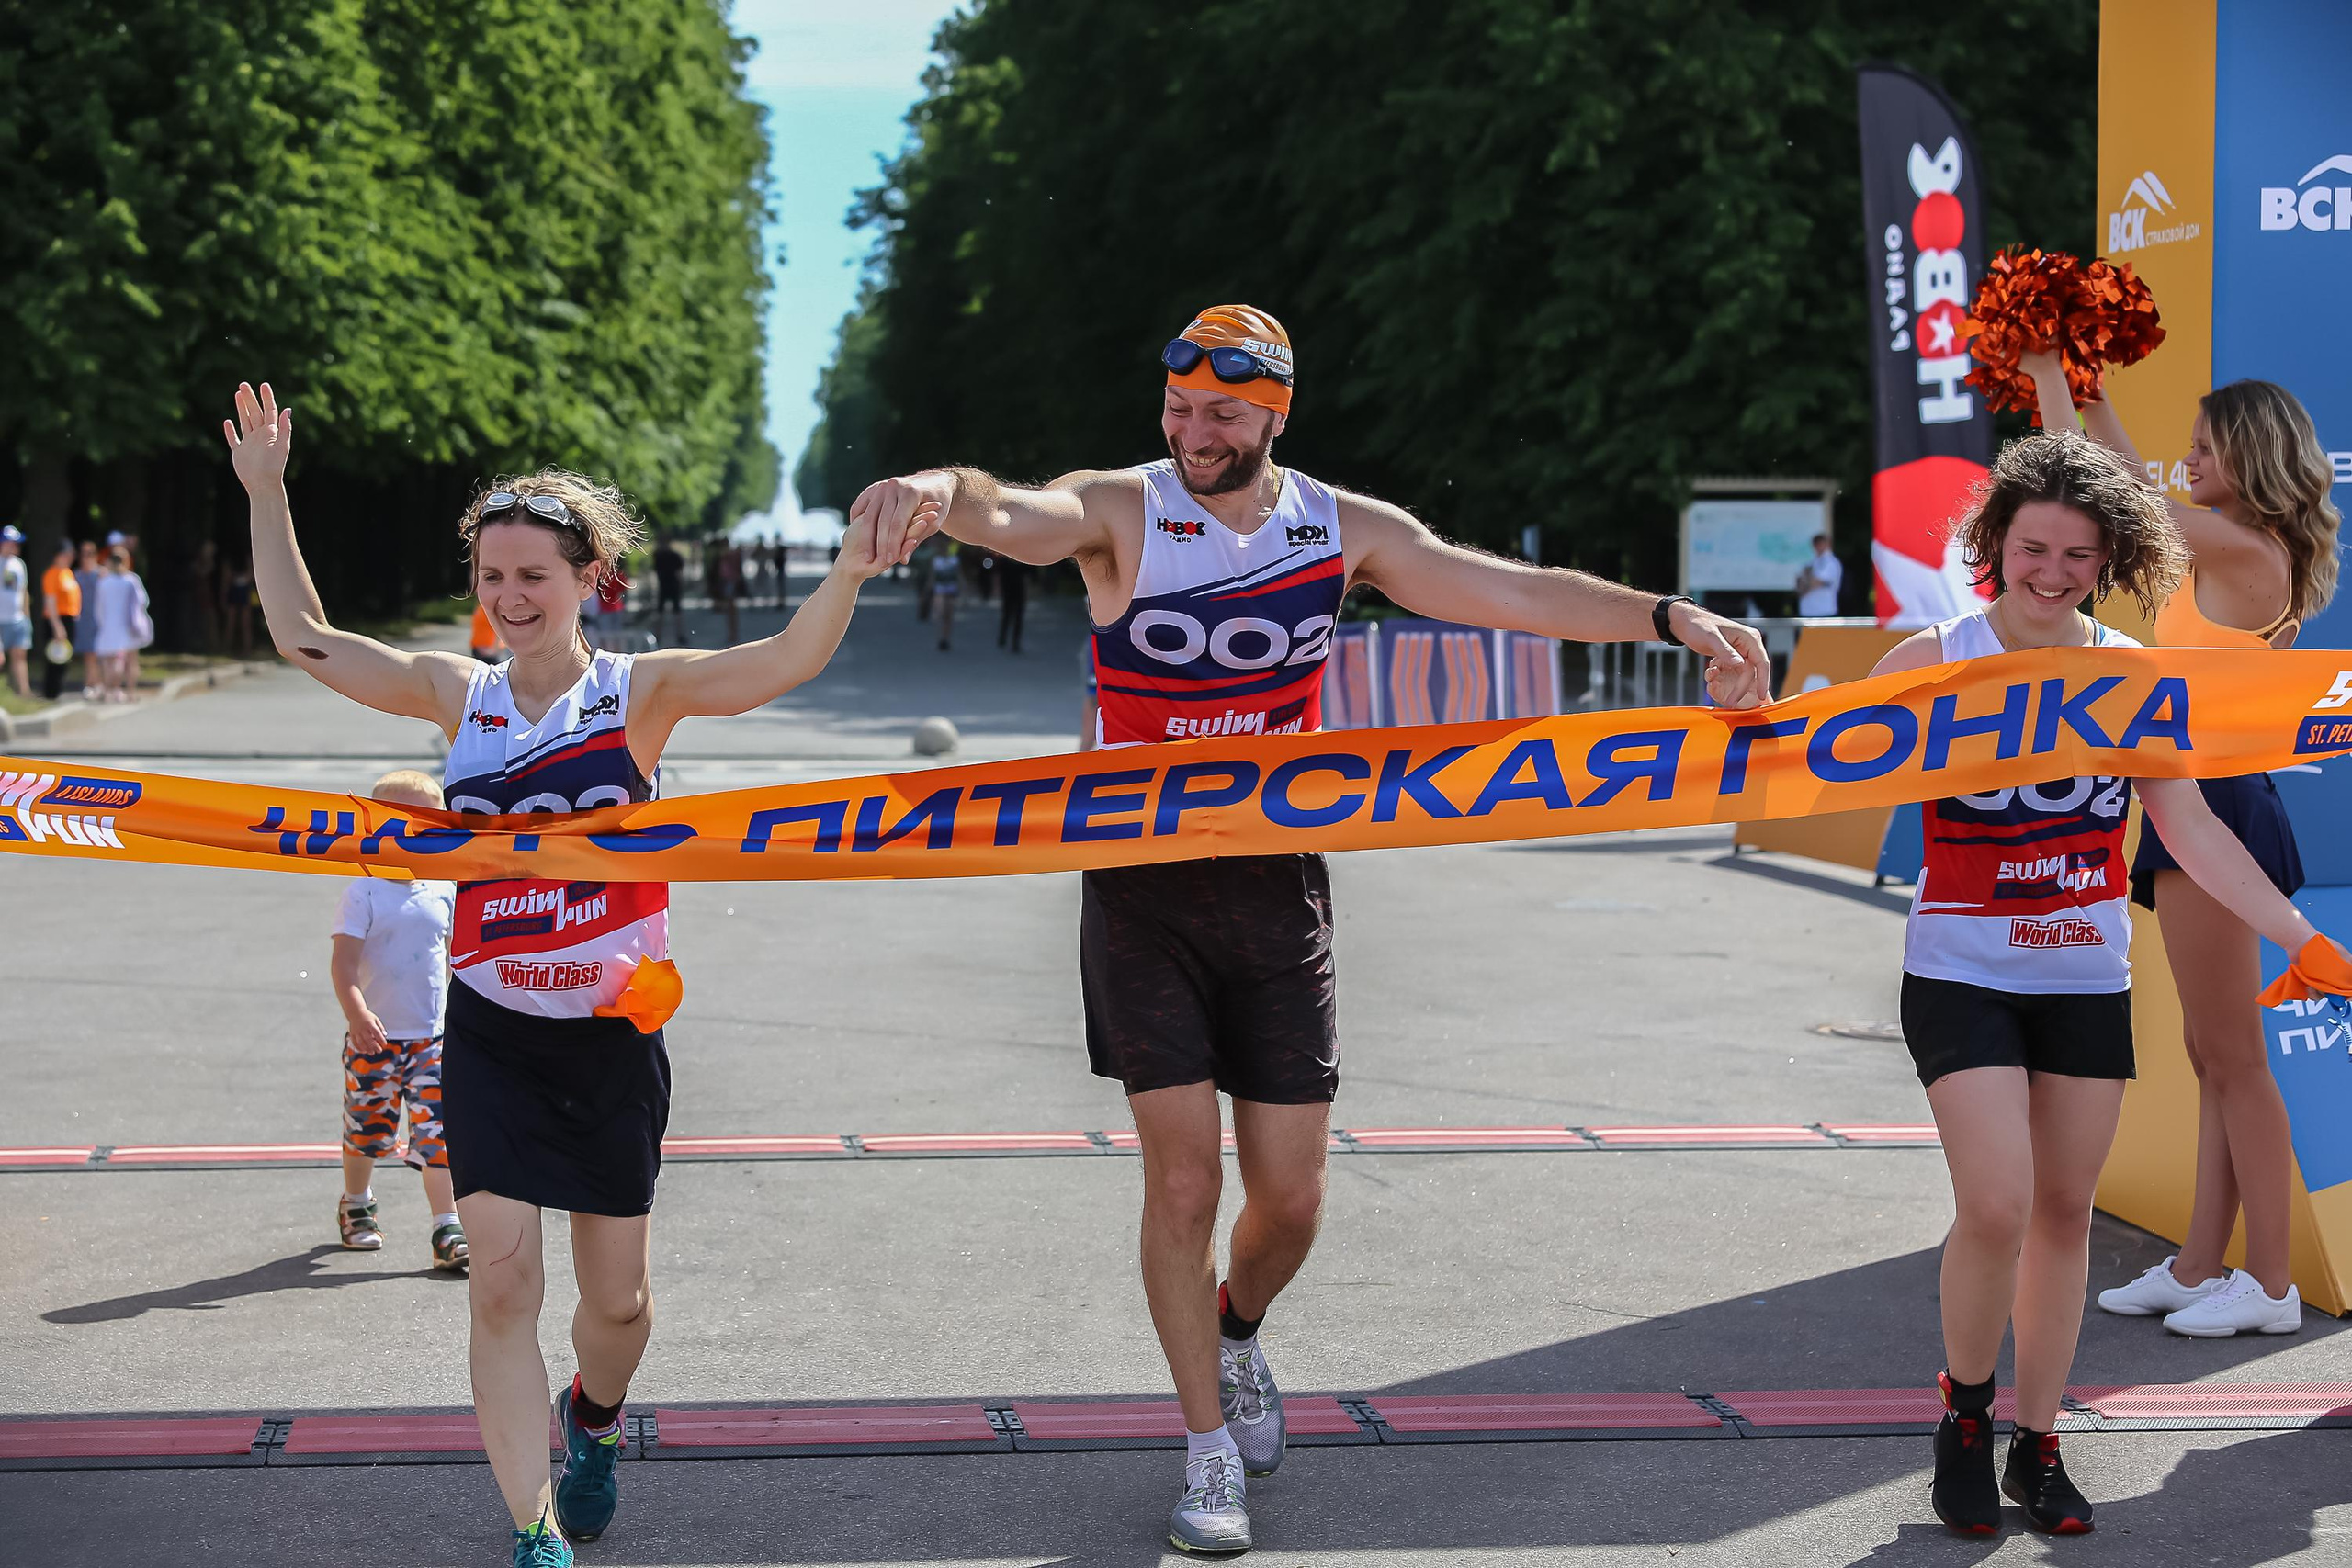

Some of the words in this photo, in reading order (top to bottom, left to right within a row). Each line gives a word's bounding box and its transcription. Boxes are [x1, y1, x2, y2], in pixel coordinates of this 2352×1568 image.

[2108, 208, 2147, 254] ВСК
[1129, 609, 1333, 670] 002
[2307, 724, 2327, 745] ST.
[739, 728, 1689, 853] ПИТЕРСКАЯ
[1718, 675, 2194, 795] ГОНКА
[2014, 920, 2060, 946] World
[2062, 919, 2104, 945] Class
[497, 963, 551, 989] World
[552, 963, 600, 989] Class
